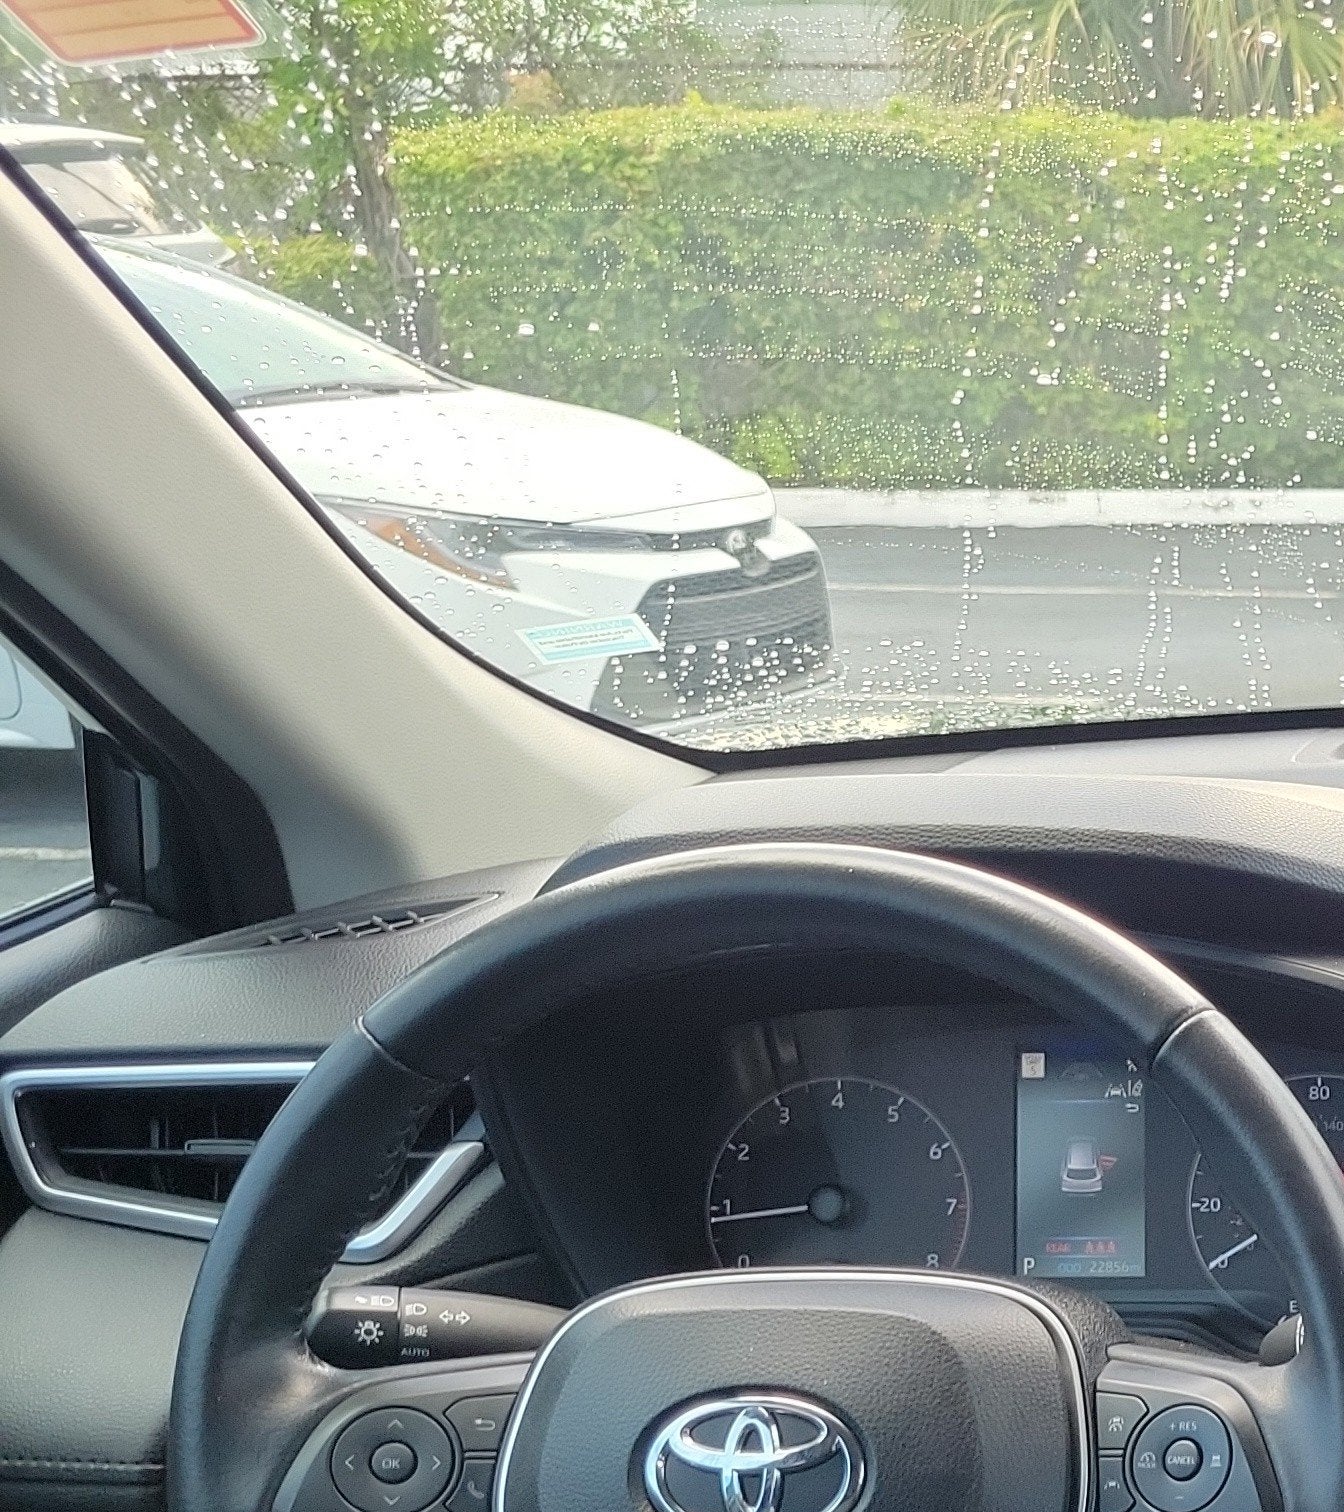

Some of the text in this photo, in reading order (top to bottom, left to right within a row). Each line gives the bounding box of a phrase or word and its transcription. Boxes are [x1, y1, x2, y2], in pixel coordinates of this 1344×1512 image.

[831, 1092, 844, 1109] 4
[1308, 1085, 1331, 1101] 80
[779, 1107, 790, 1124] 3
[887, 1105, 899, 1123] 5
[737, 1143, 750, 1161] 2
[929, 1142, 942, 1160] 6
[945, 1198, 957, 1216] 7
[1198, 1197, 1221, 1213] 20
[1023, 1257, 1035, 1276] P
[1289, 1299, 1299, 1314] E
[400, 1346, 430, 1358] AUTO
[381, 1458, 401, 1469] OK
[1167, 1454, 1196, 1466] CANCEL
